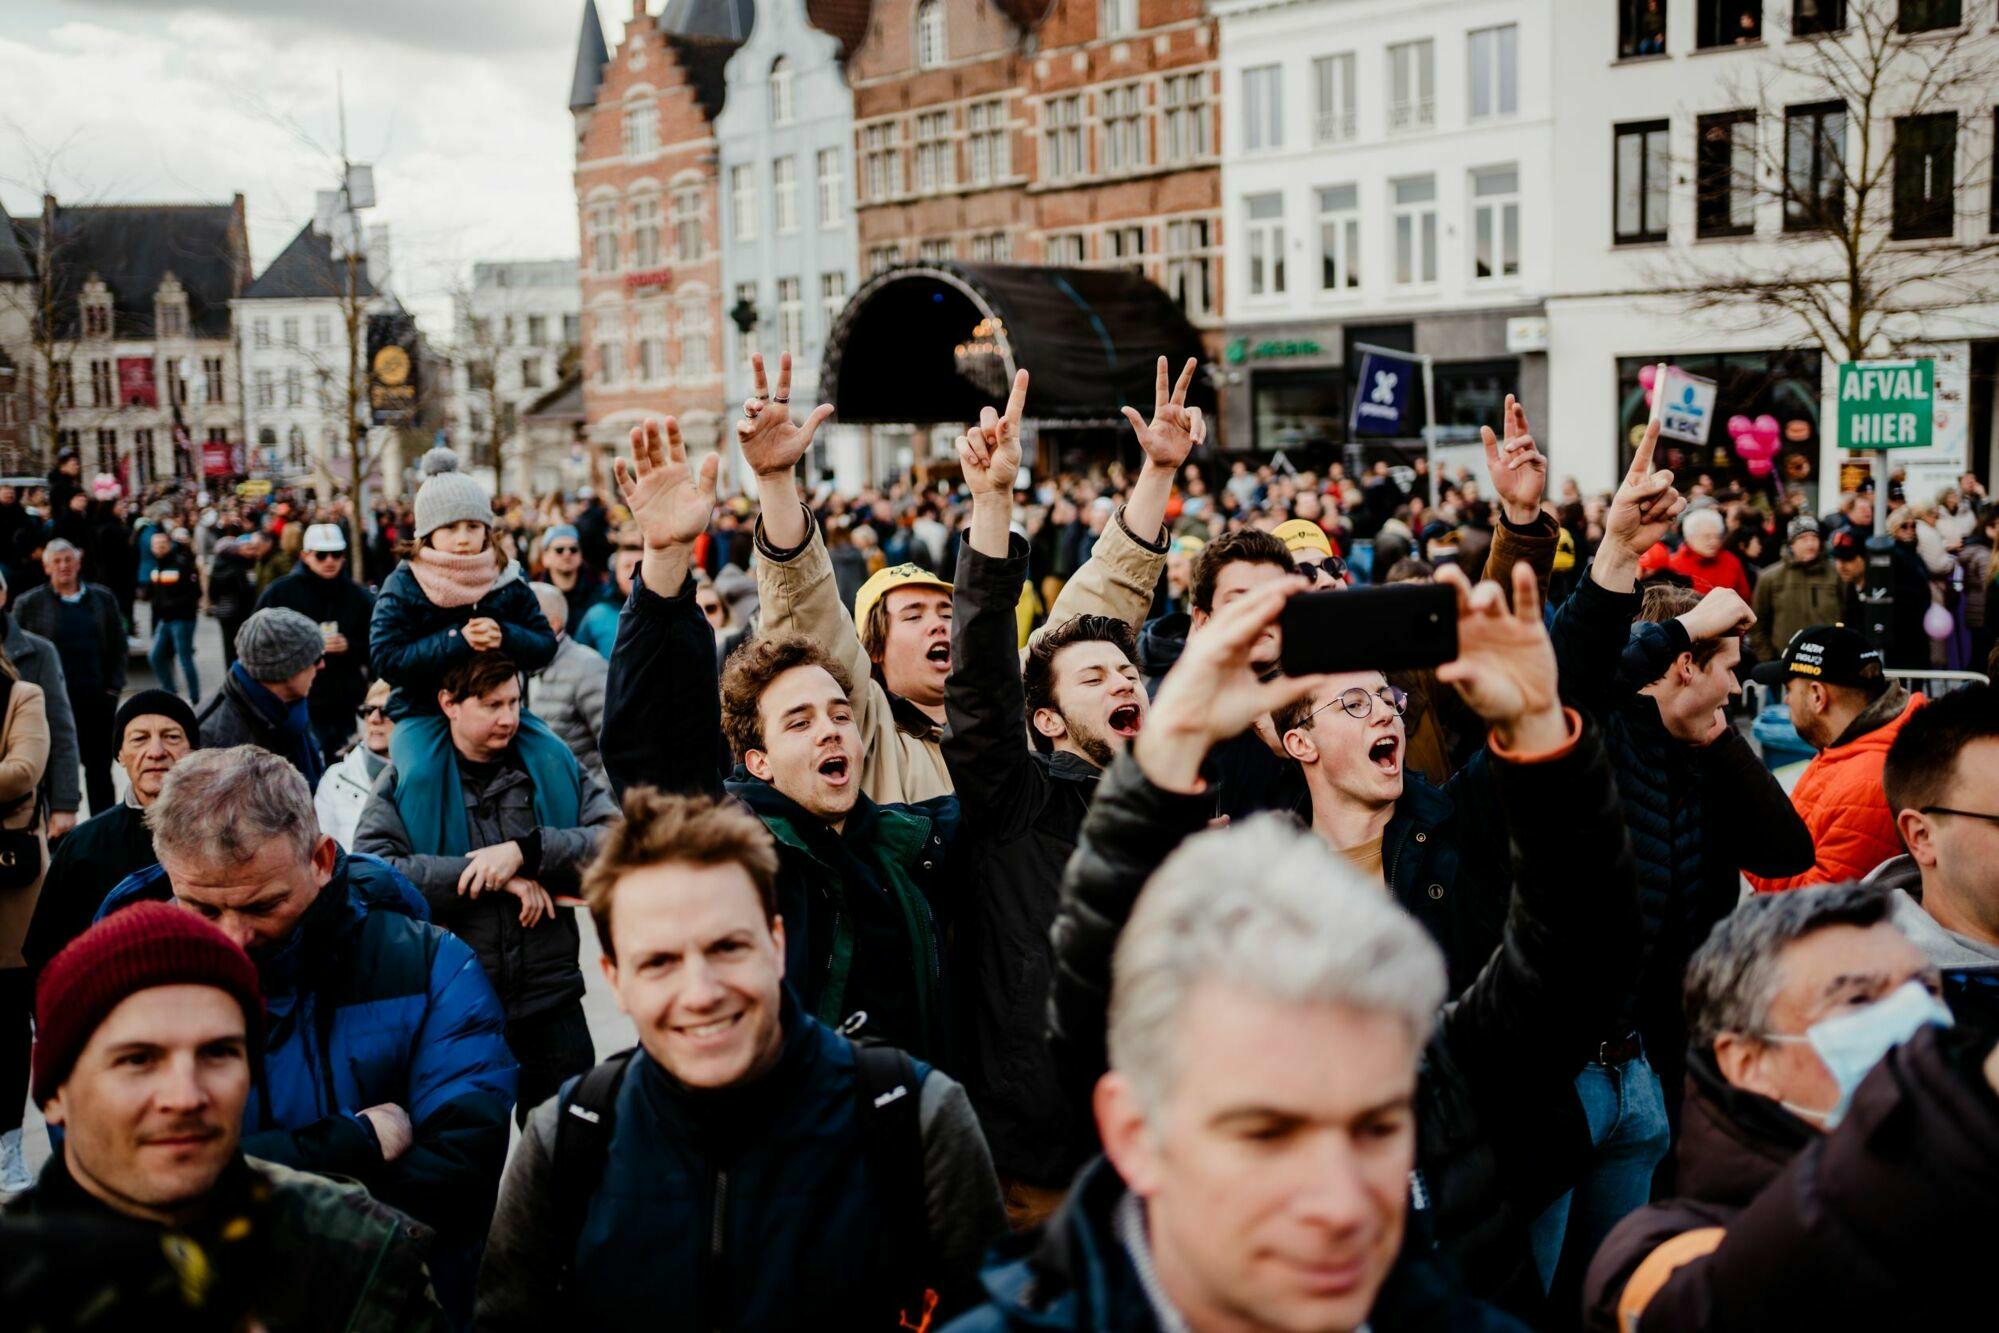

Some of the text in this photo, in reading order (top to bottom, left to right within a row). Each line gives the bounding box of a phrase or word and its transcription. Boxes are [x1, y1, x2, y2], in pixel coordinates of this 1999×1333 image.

[1842, 369, 1929, 400] AFVAL
[1851, 413, 1917, 443] HIER
[1800, 642, 1825, 654] LAZER
[1789, 662, 1822, 676] JUMBO
